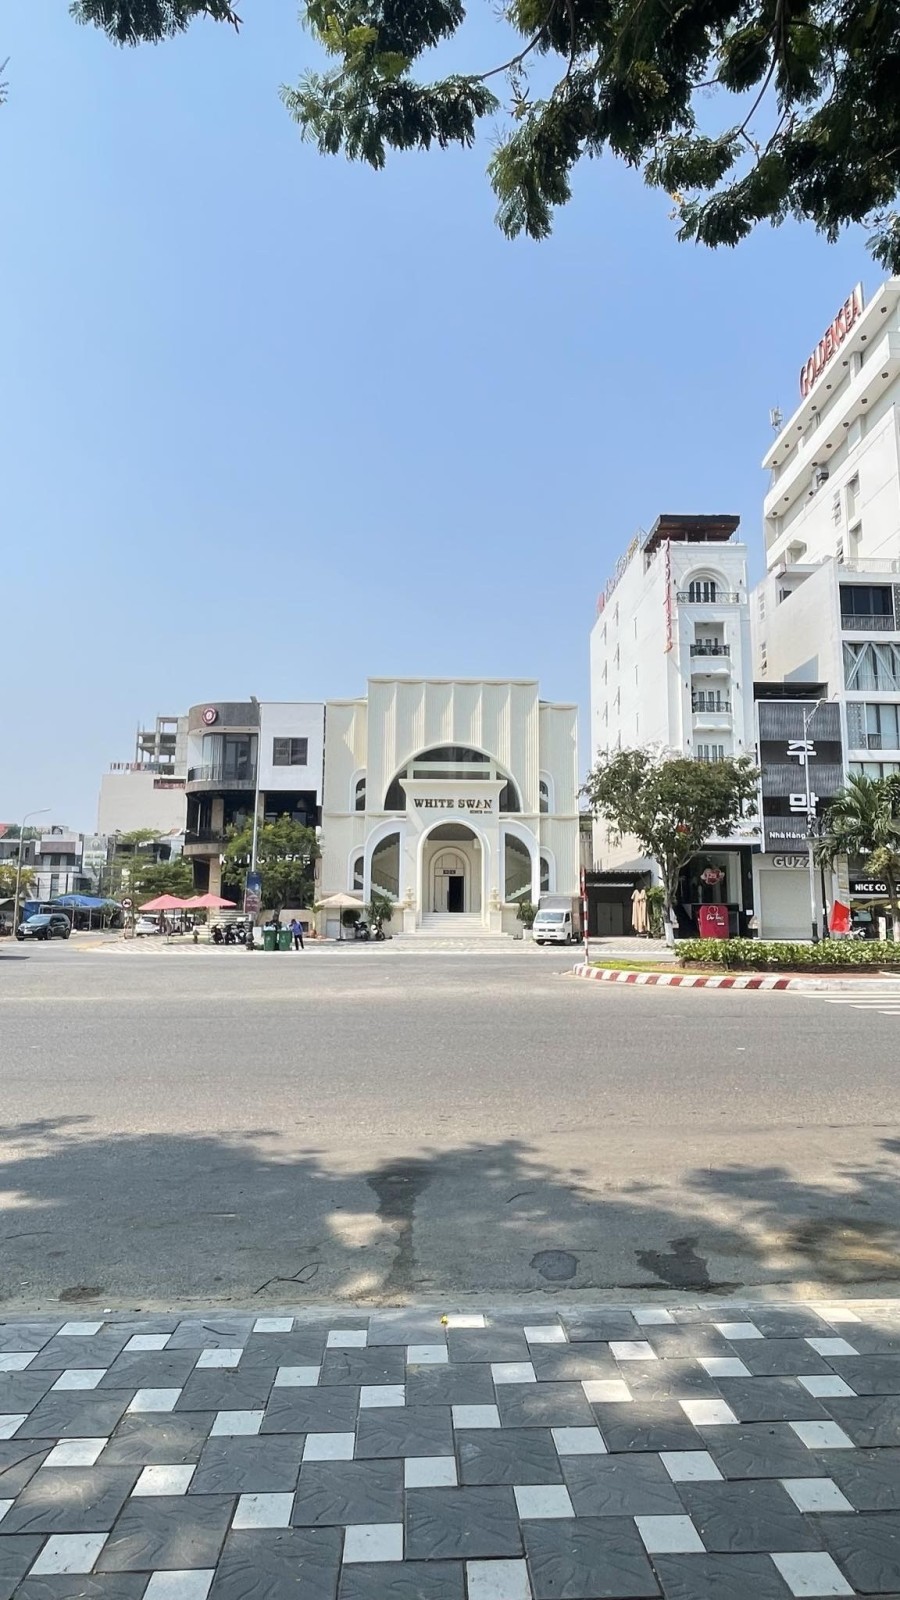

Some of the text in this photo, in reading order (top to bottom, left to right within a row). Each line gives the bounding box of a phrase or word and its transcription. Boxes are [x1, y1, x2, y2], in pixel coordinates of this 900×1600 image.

[413, 798, 493, 809] WHITE SWAN
[854, 883, 874, 892] NICE
